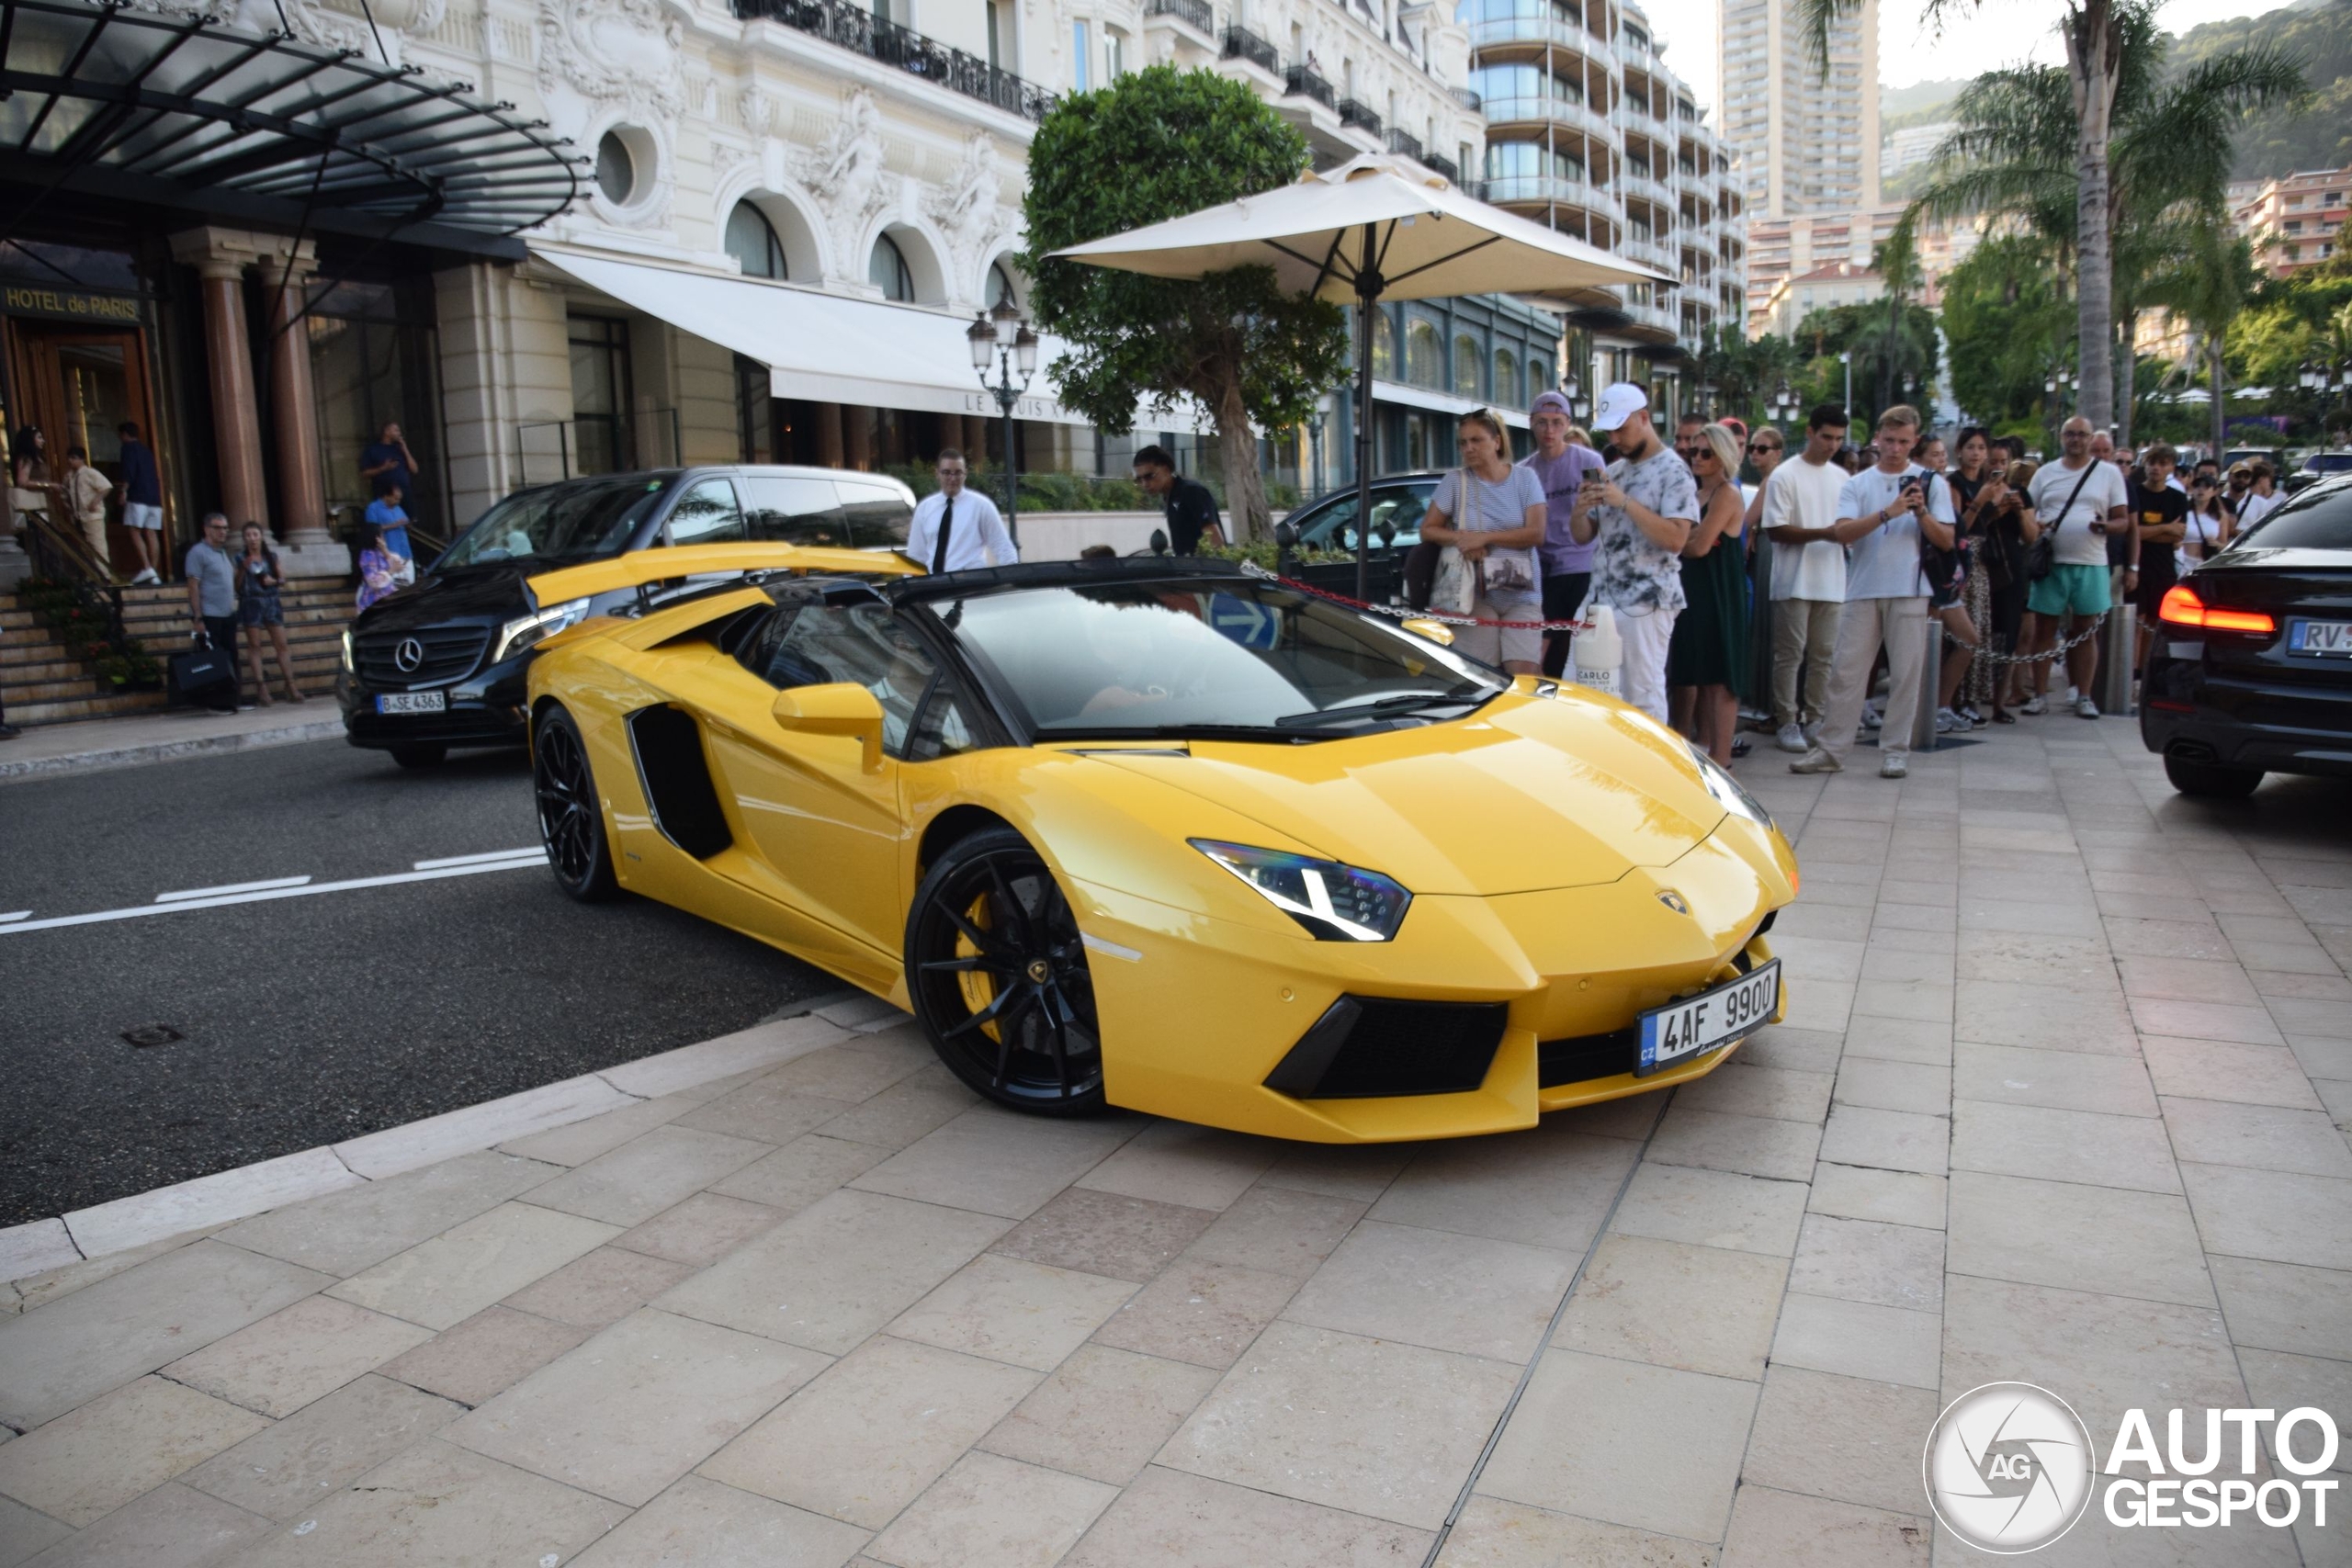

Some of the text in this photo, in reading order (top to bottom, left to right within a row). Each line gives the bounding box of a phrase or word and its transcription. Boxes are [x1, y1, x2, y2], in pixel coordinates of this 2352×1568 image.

[6, 288, 136, 318] HOTEL de PARIS
[966, 394, 984, 412] LE
[995, 400, 1043, 416] LUIS
[2305, 625, 2342, 649] RV
[397, 695, 412, 710] SE
[413, 694, 444, 709] 4363
[1663, 974, 1771, 1052] 4AF 9900
[1641, 1047, 1655, 1061] CZ
